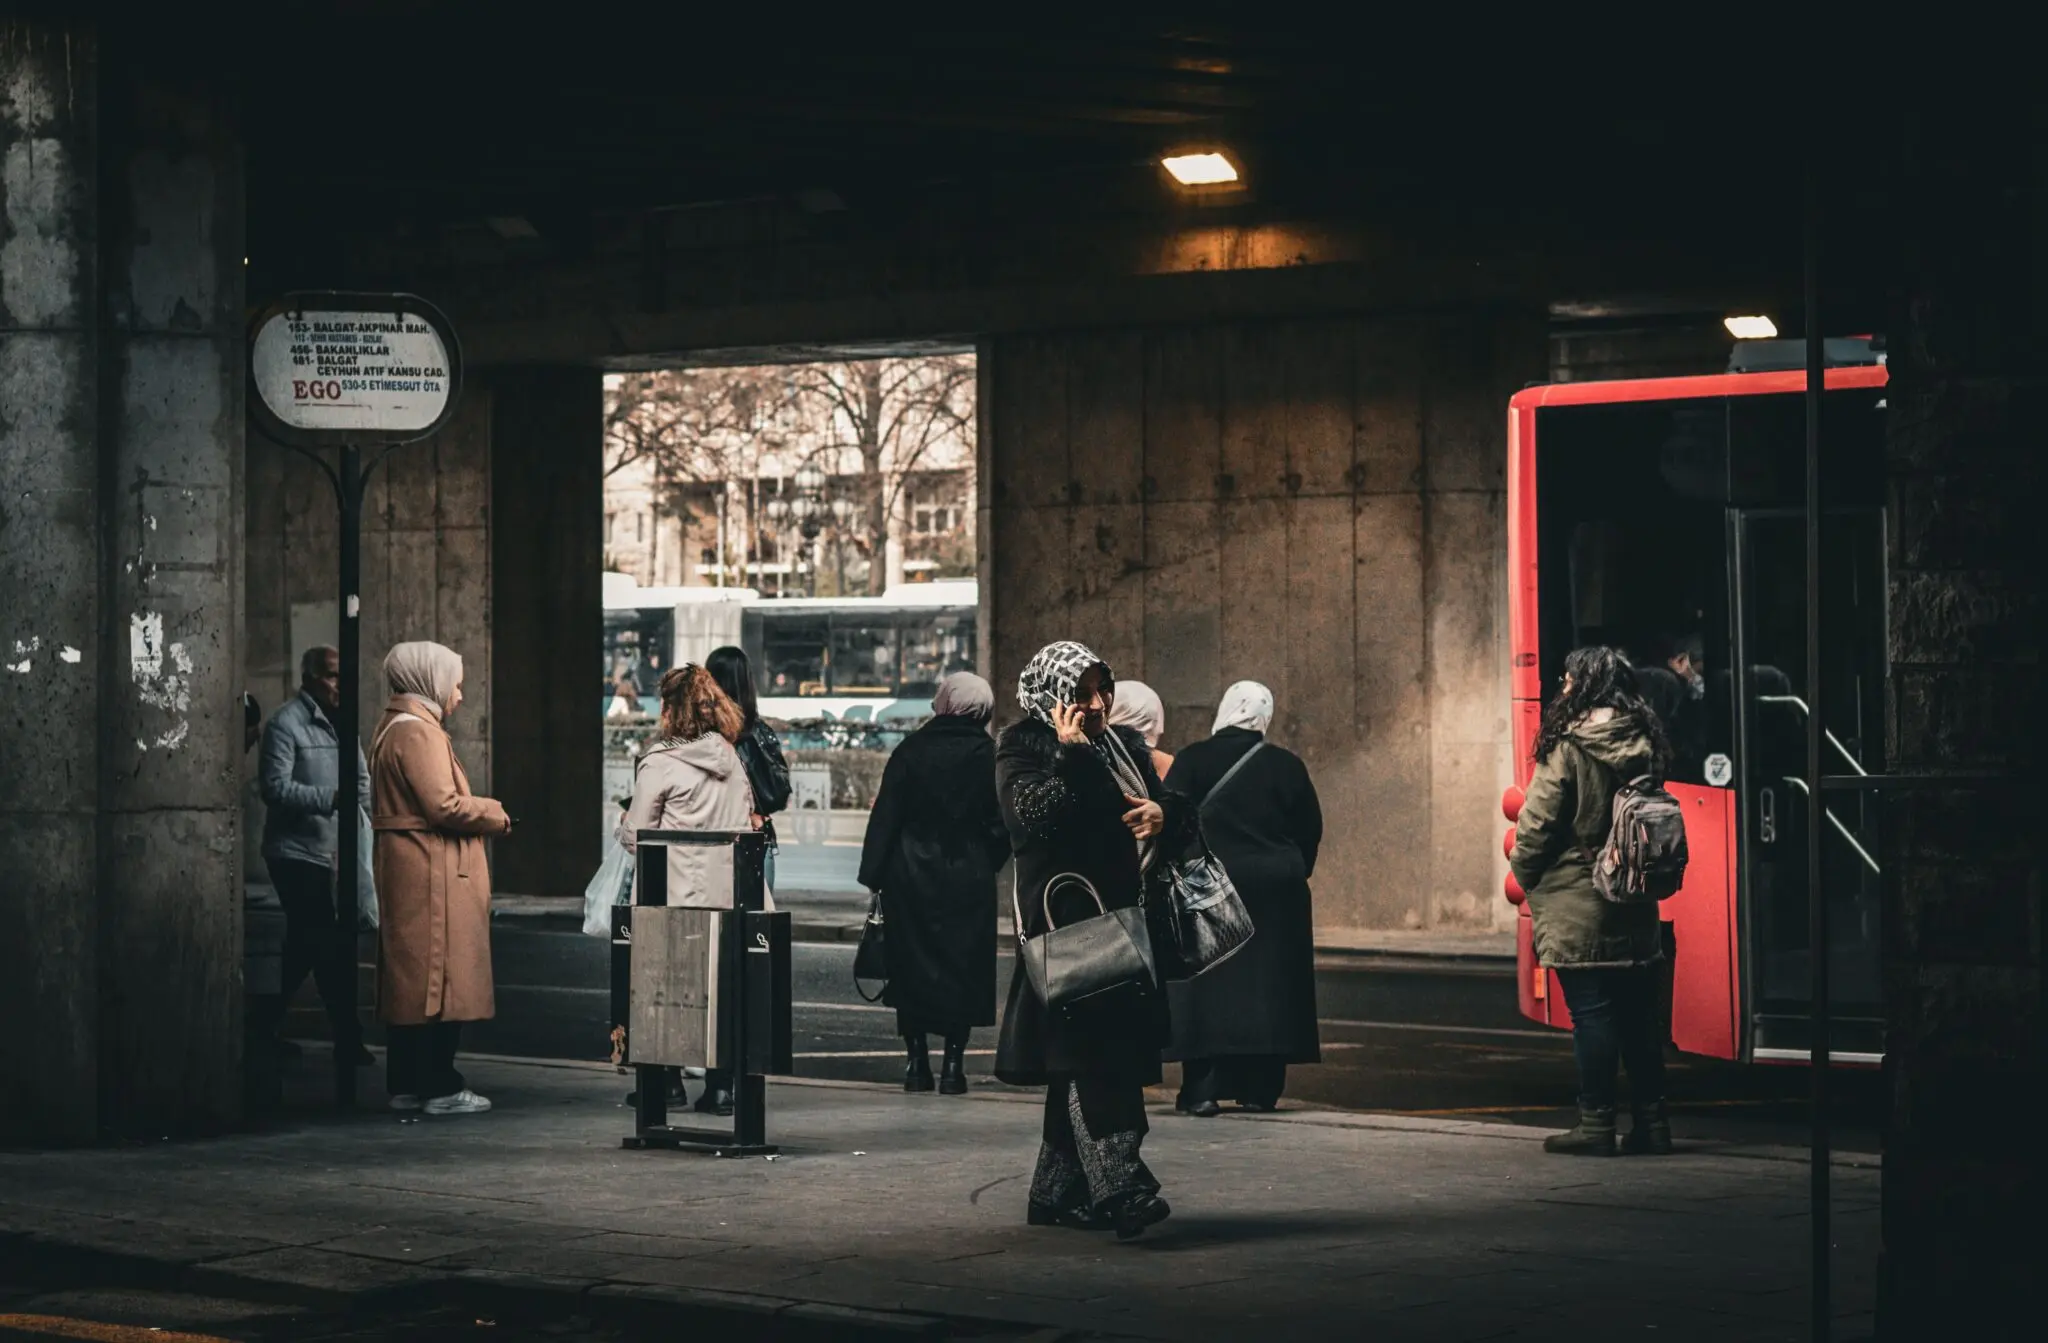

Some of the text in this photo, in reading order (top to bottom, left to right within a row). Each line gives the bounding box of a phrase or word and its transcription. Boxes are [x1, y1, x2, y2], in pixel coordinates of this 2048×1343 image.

[313, 323, 403, 333] BALGAT-AKPINAR
[405, 324, 430, 334] MAH.
[316, 345, 390, 355] BAKANLIKLAR
[317, 356, 358, 365] BALGAT
[317, 366, 446, 377] CEYHUN ATIF KANSU CAD.
[293, 380, 342, 400] EGO
[342, 380, 367, 390] 530-5
[369, 379, 421, 392] ETİMESGUT
